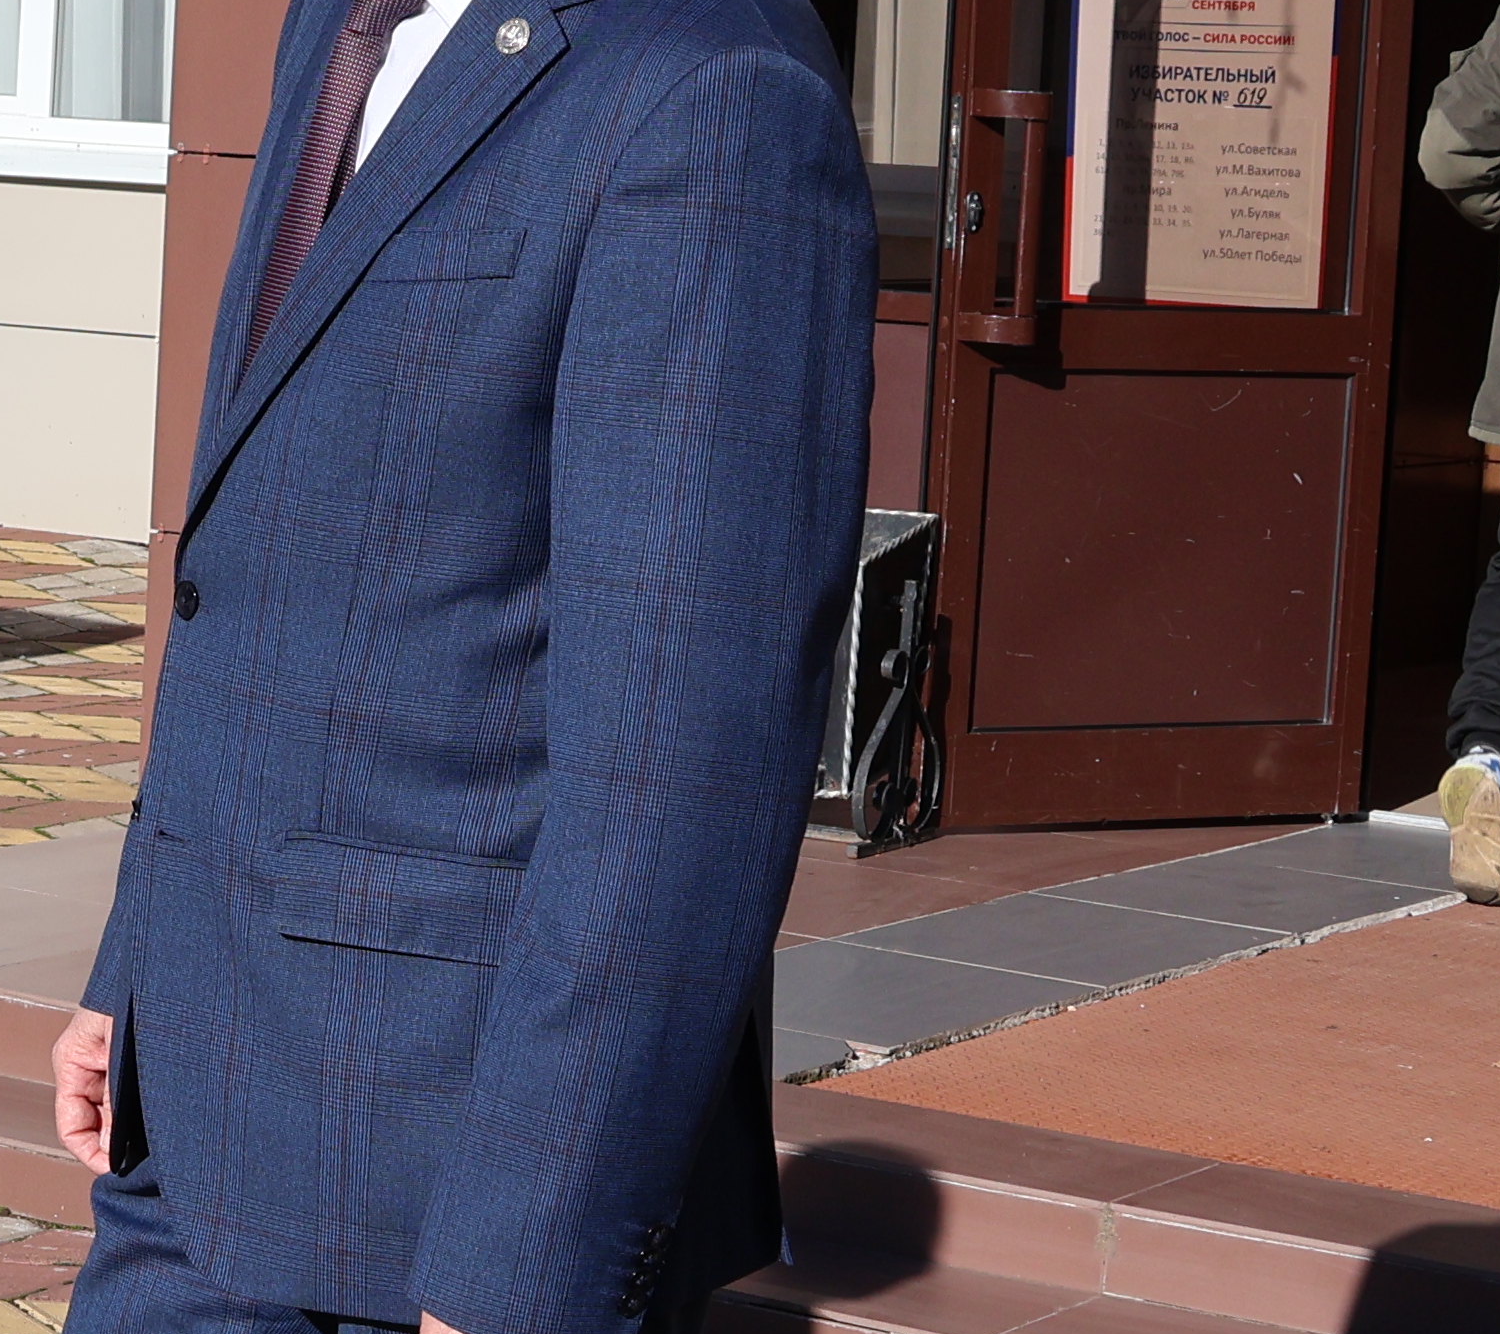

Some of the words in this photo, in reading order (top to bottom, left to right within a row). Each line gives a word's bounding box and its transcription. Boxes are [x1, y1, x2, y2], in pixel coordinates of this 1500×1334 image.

[1192, 0, 1256, 12] СЕНТЯБРЯ
[1203, 32, 1237, 44] СИЛА
[1240, 34, 1295, 46] РОССИИ!
[1129, 65, 1276, 84] ИЗБИРАТЕЛЬНЫЙ
[1131, 87, 1207, 104] УЧАСТОК
[1212, 89, 1229, 104] №
[1236, 87, 1267, 105] 619
[1221, 143, 1297, 156] ул.Советская
[1215, 164, 1301, 178] ул.М.Вахитова
[1224, 185, 1290, 199] ул.Агидель
[1230, 206, 1281, 221] ул.Буляк
[1219, 227, 1290, 242] ул.Лагерная
[1255, 250, 1302, 265] Победы
